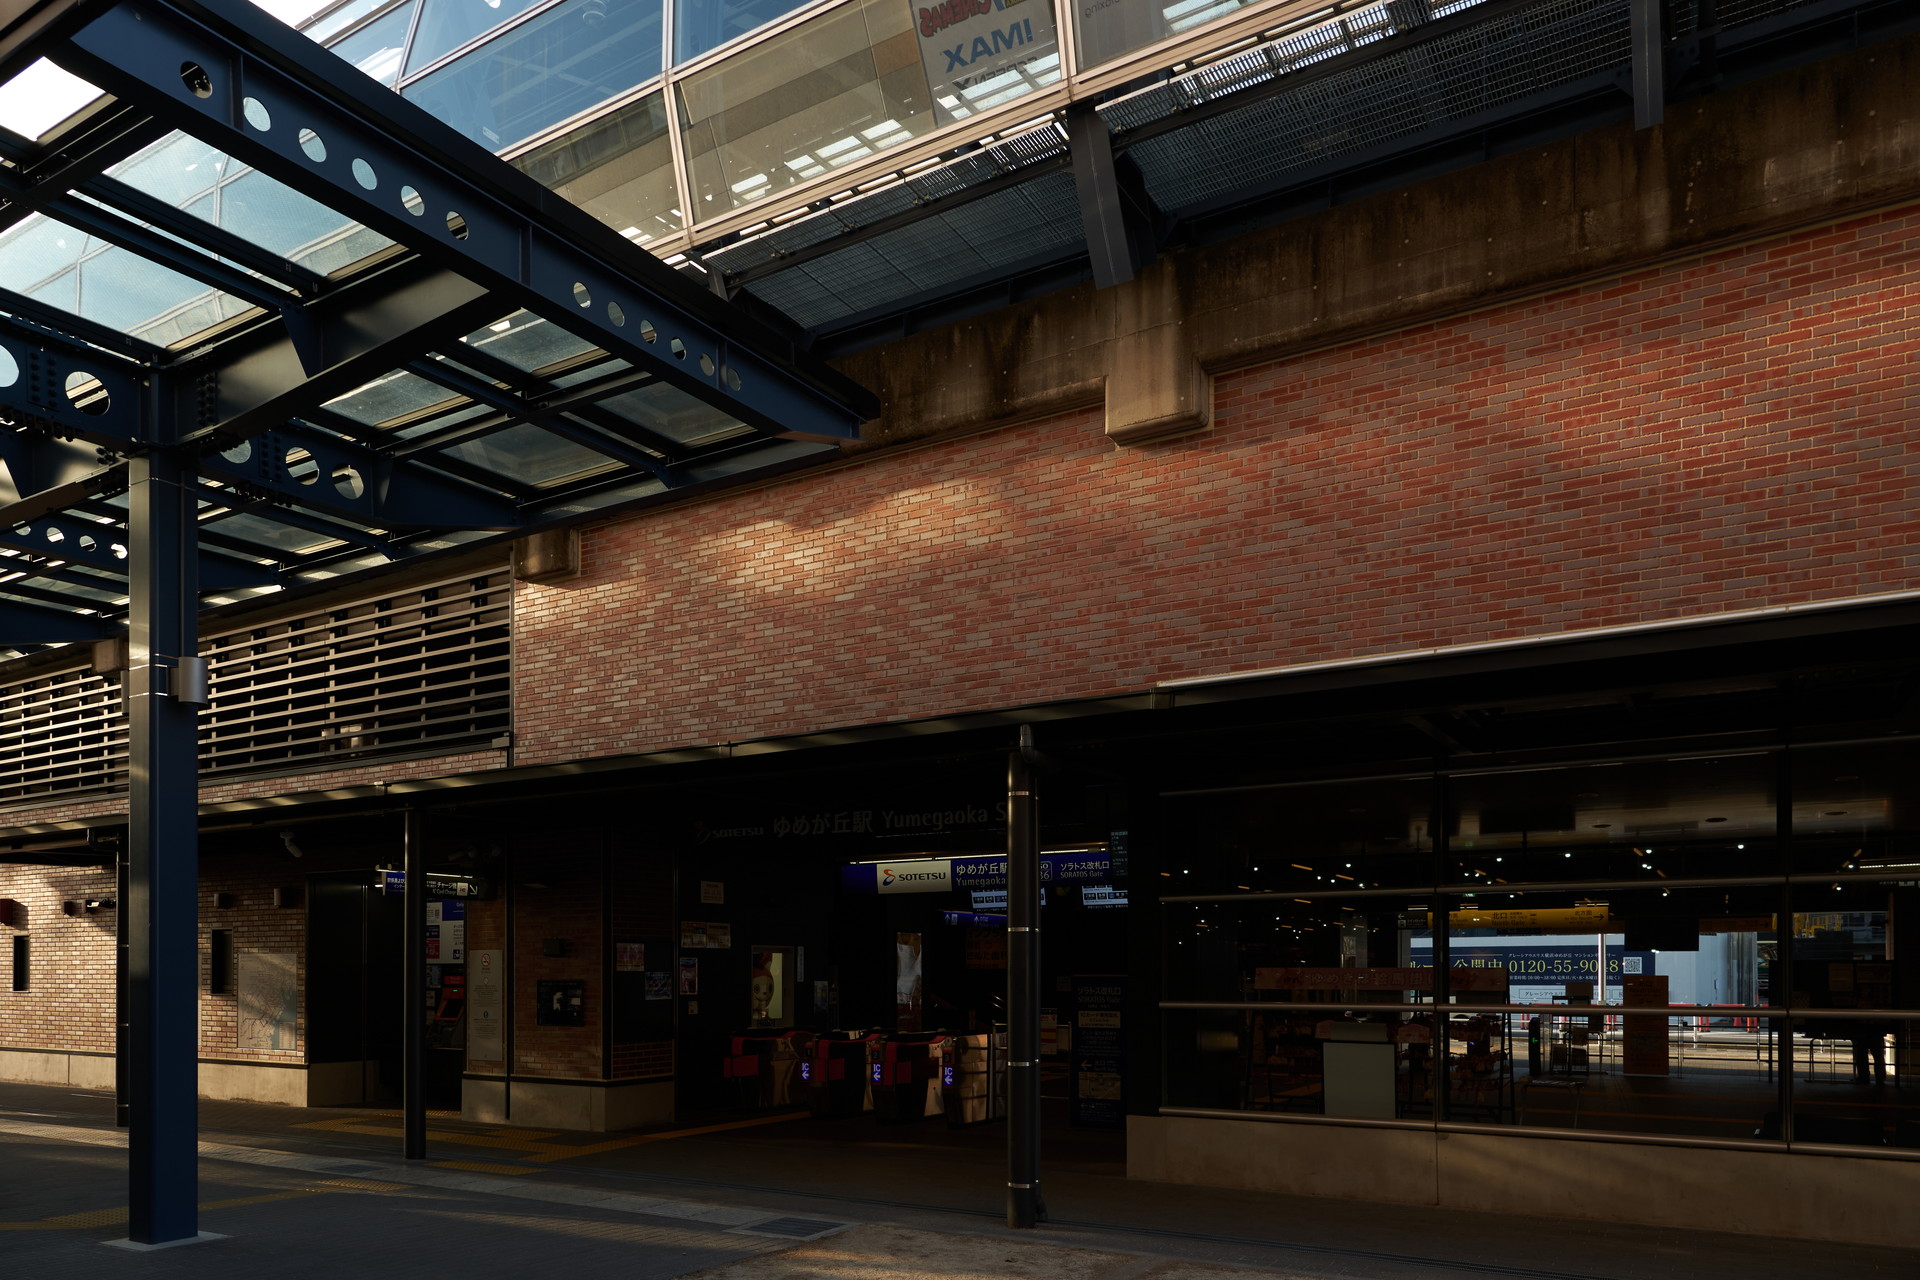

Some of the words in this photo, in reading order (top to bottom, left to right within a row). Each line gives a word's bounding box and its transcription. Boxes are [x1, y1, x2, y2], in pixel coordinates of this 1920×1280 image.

[772, 809, 873, 838] ゆめが丘駅
[881, 803, 988, 831] Yumegaoka
[1060, 861, 1110, 871] ソラトス改札口
[898, 872, 946, 883] SOTETSU
[1060, 870, 1088, 879] SORATOS
[1089, 870, 1104, 878] Gate
[956, 876, 1006, 887] Yumegaoka
[1509, 959, 1619, 973] 0120-55-908
[801, 1062, 810, 1071] IC
[873, 1063, 881, 1072] IC
[944, 1067, 953, 1076] IC
